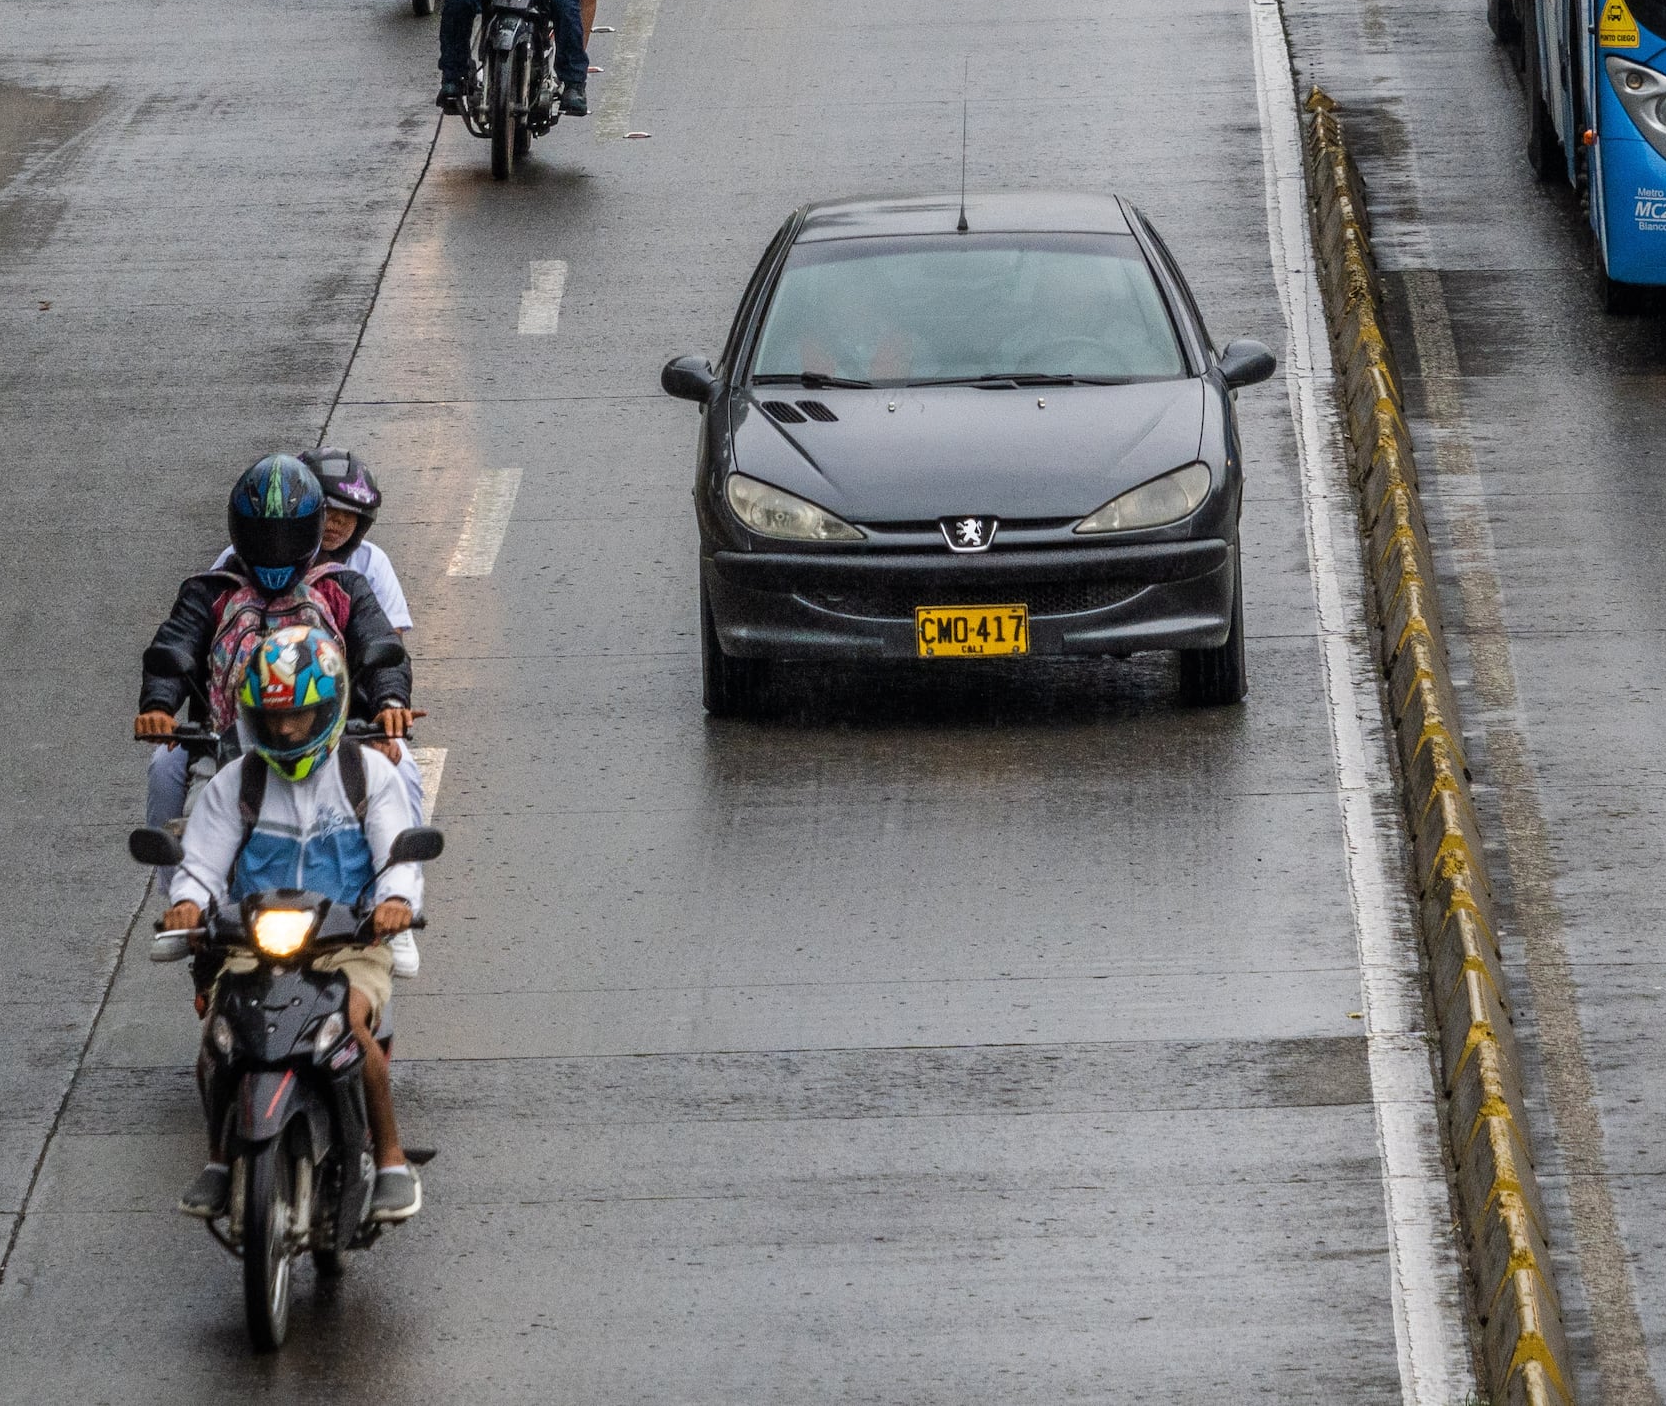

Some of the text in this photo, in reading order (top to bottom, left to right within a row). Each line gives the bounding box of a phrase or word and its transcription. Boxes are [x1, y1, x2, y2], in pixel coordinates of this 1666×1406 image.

[1617, 34, 1636, 42] CIEGO
[1637, 187, 1664, 197] Metro
[961, 645, 985, 654] CALI
